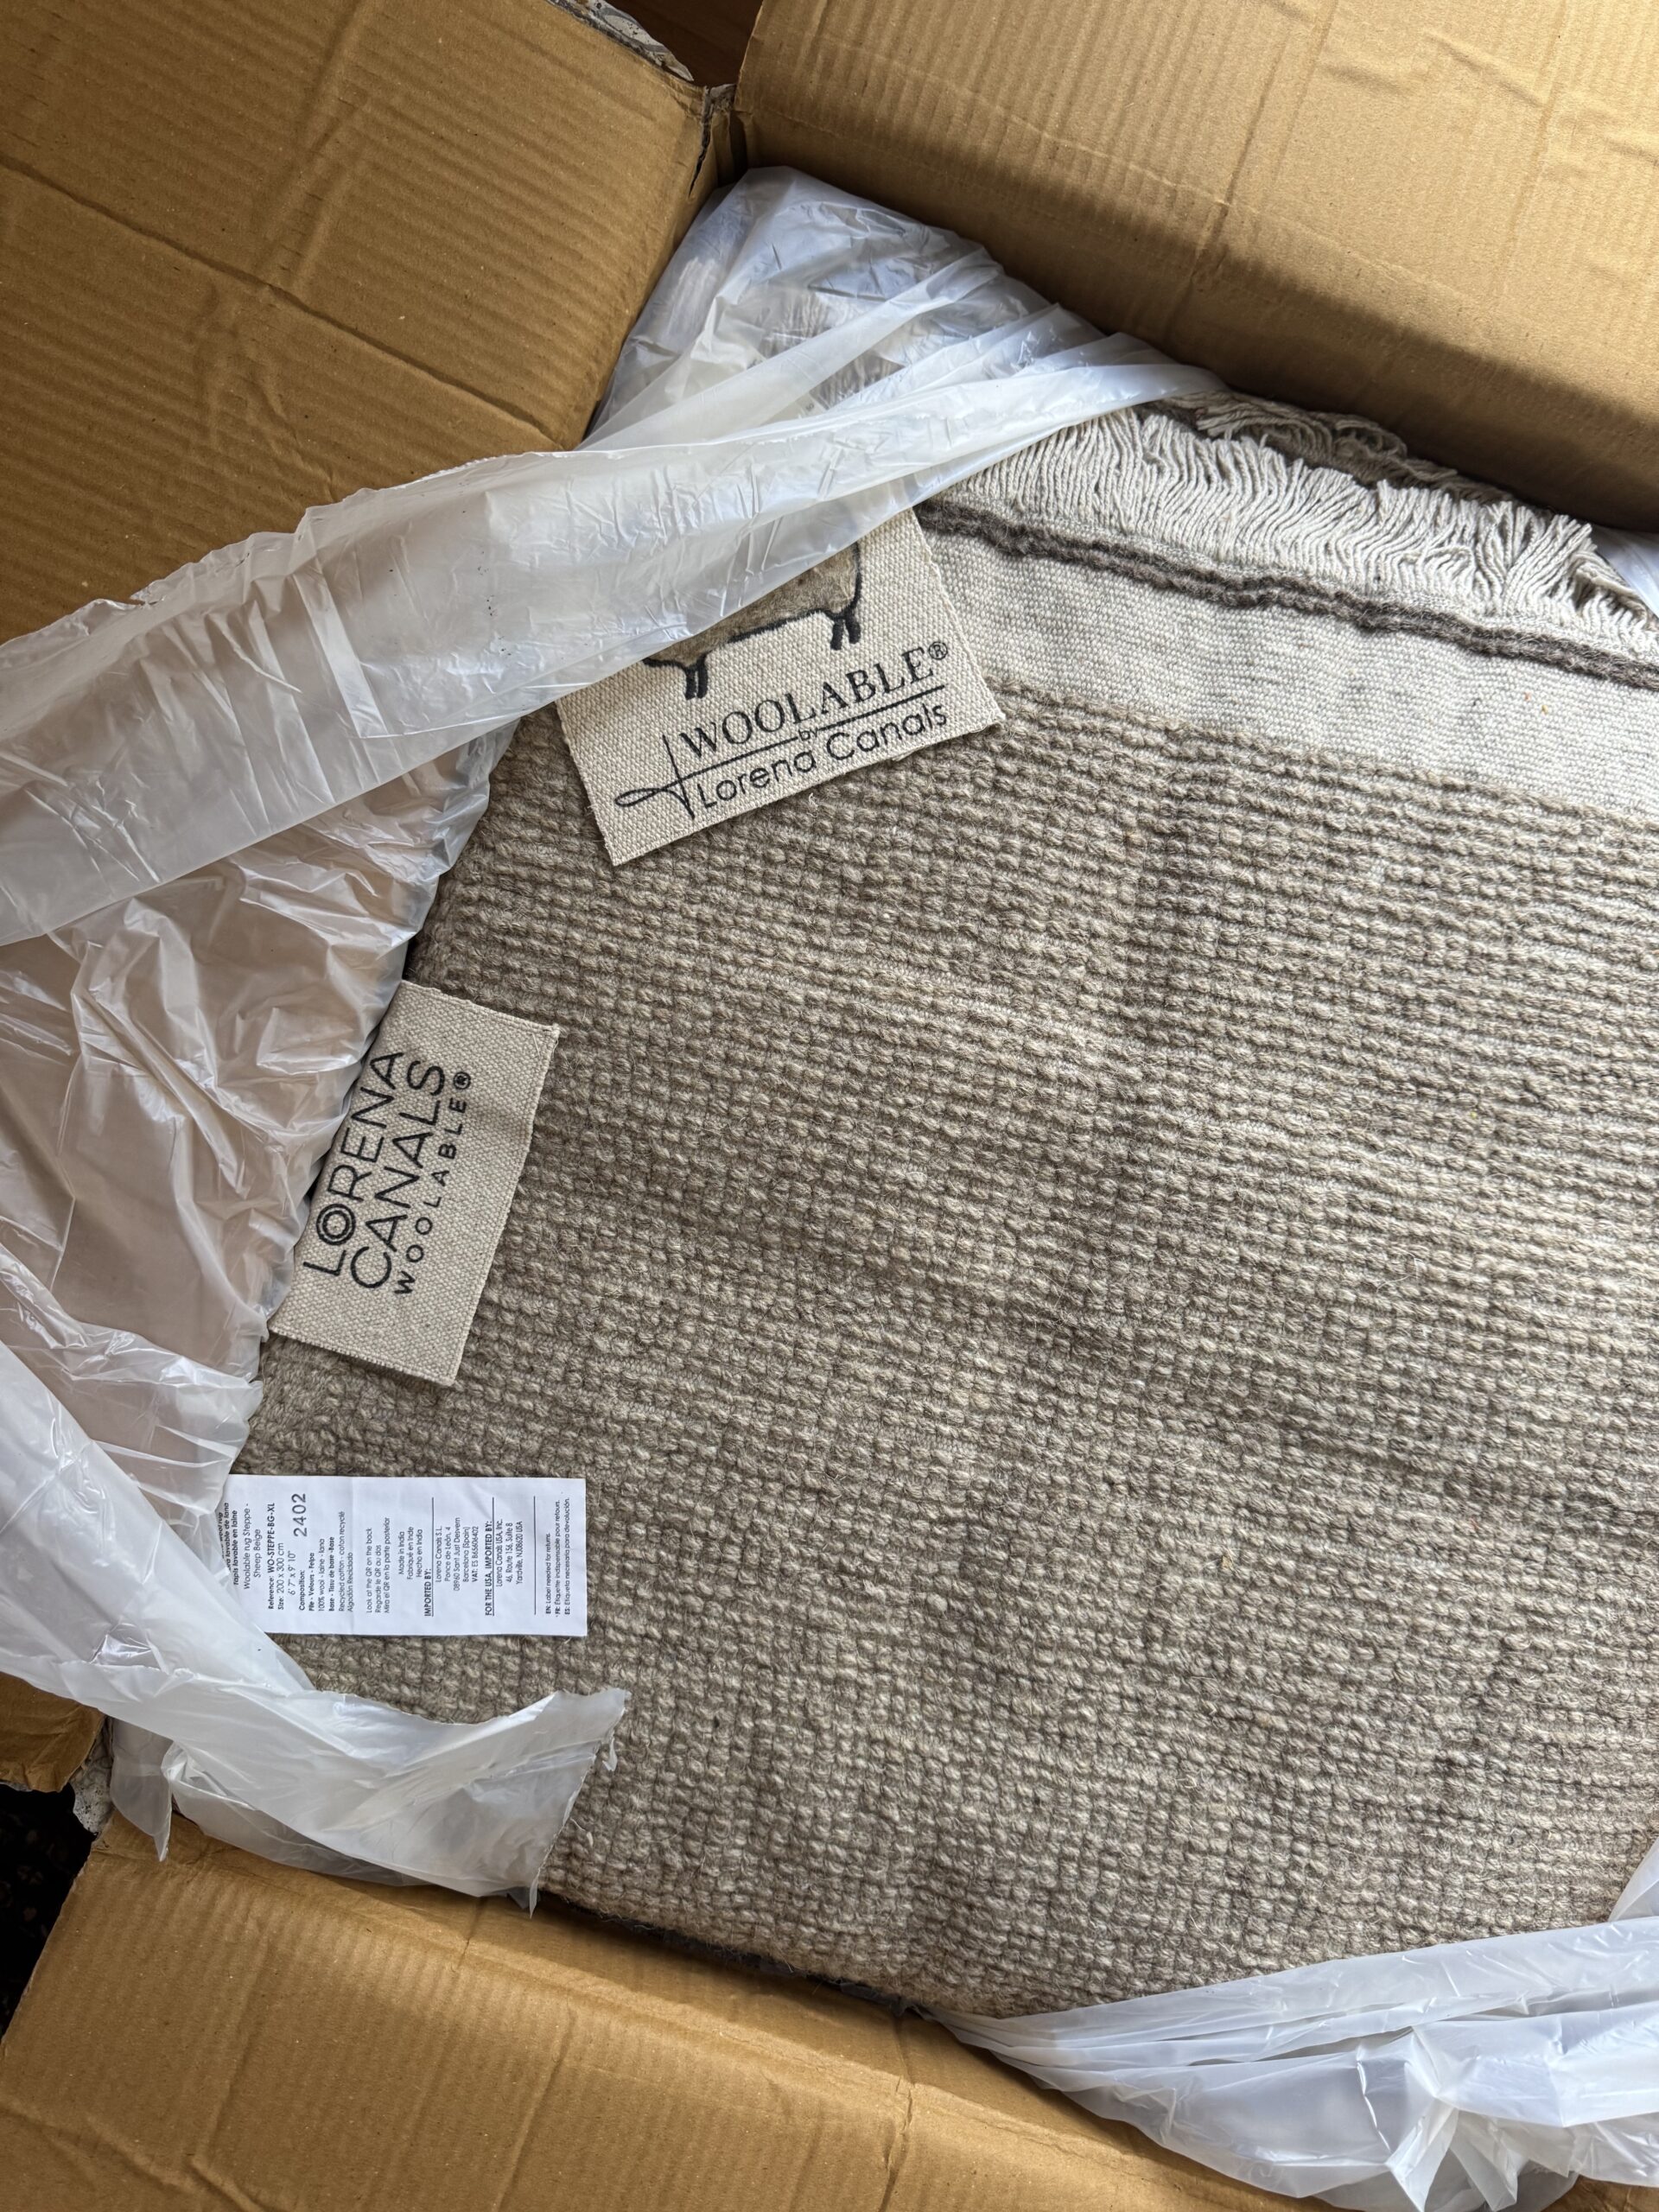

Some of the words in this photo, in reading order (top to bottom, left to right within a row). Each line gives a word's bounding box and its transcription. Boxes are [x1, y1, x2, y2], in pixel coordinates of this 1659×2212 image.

[798, 728, 820, 743] by
[696, 747, 817, 809] Lorena
[825, 702, 948, 761] Canals
[303, 1052, 404, 1276] LORENA
[350, 1060, 445, 1289] CANALS
[243, 1509, 251, 1535] Steppe
[291, 1493, 307, 1536] 2402
[224, 1520, 229, 1529] de
[253, 1529, 262, 1551] Beige
[277, 1543, 283, 1555] cm
[367, 1557, 372, 1566] on
[445, 1551, 451, 1560] de
[253, 1554, 262, 1578] Sheep
[366, 1567, 372, 1576] QR
[375, 1568, 381, 1577] QR
